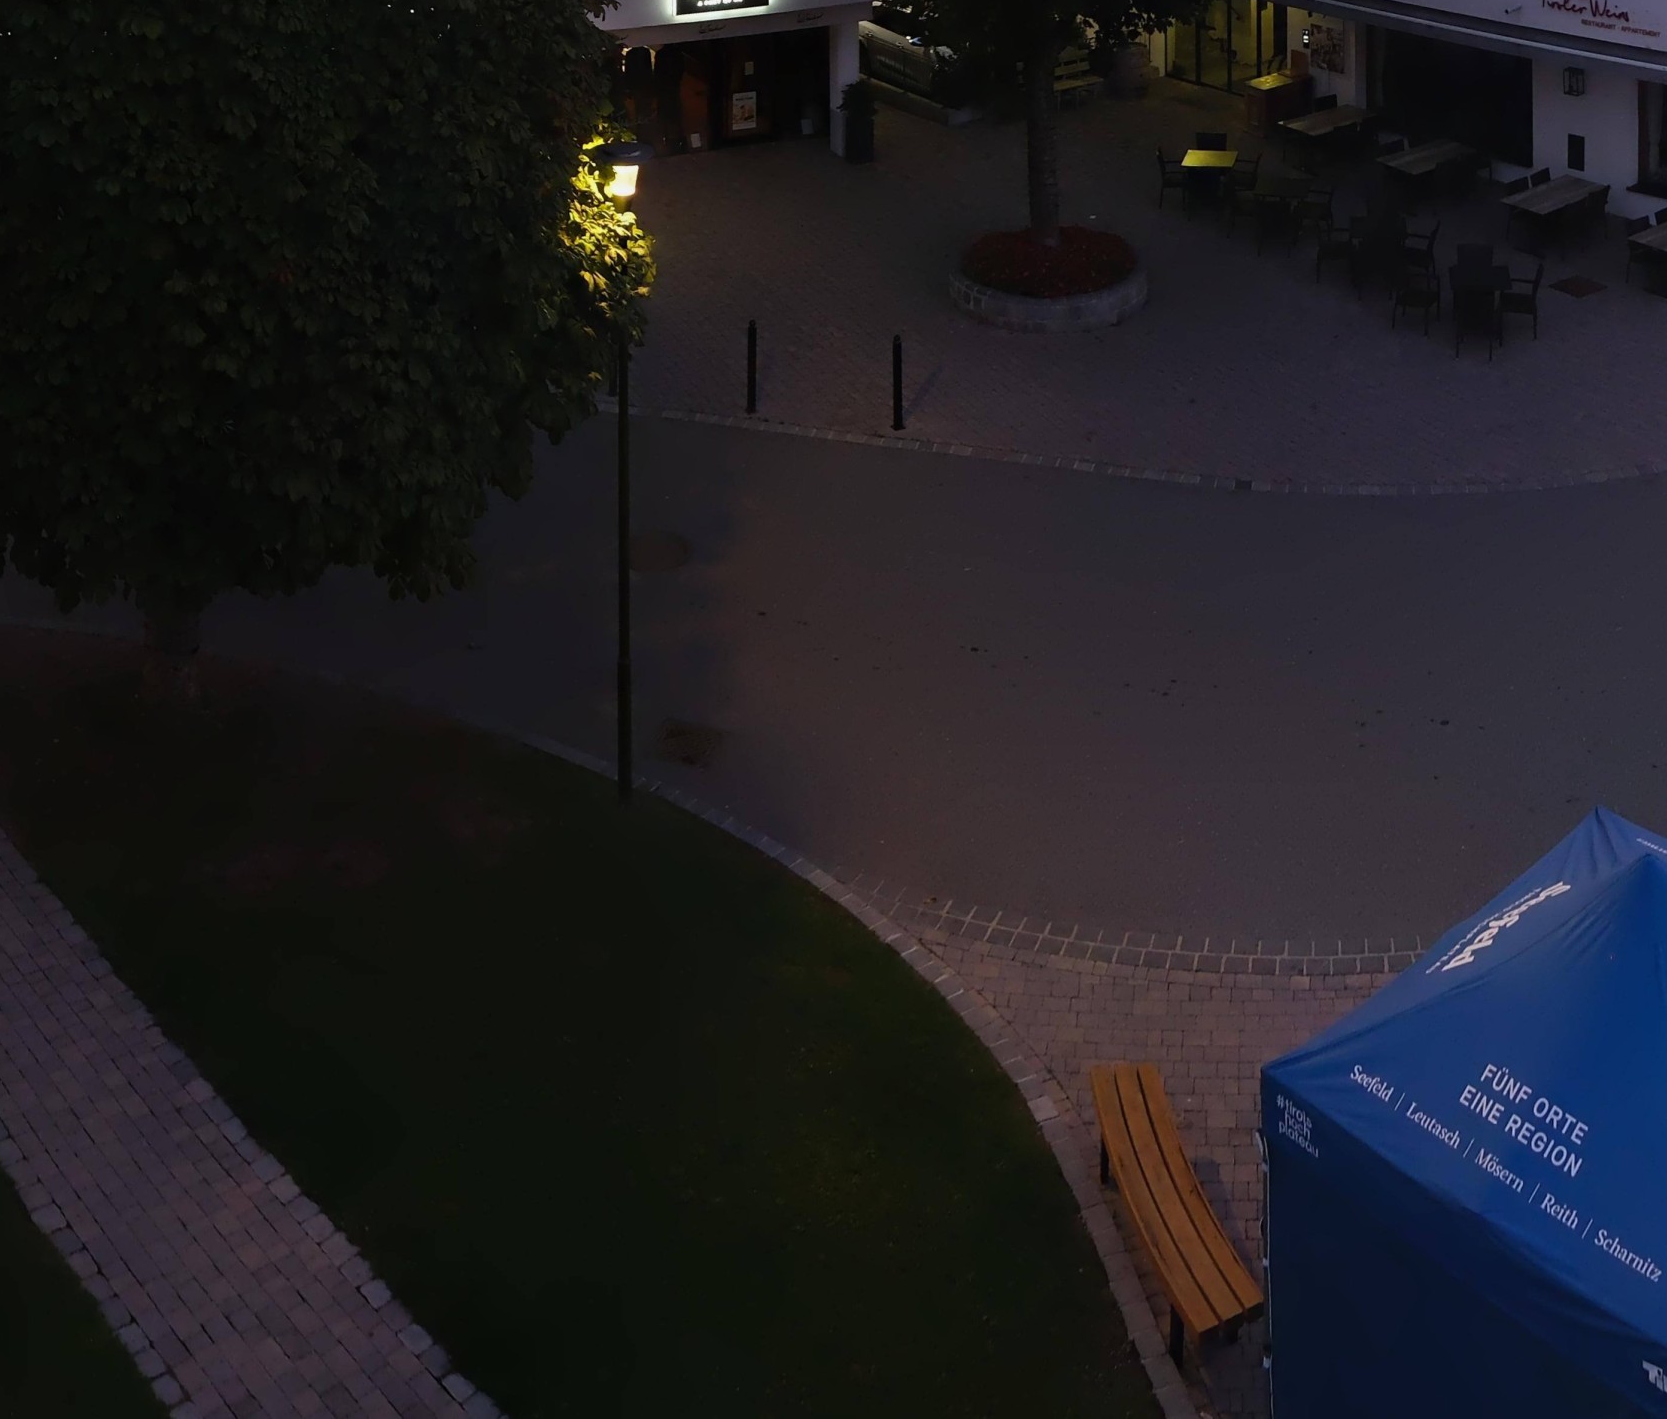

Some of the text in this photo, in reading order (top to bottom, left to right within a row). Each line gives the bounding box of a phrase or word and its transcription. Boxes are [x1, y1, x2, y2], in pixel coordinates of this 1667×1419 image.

[1278, 1121, 1319, 1158] plateau
[1284, 1109, 1311, 1141] hoch
[1459, 1084, 1583, 1178] EINE REGION
[1480, 1062, 1589, 1145] FÜNF ORTE
[1350, 1064, 1663, 1282] Seefeld Leutasch Mösern Reith Scharnitz
